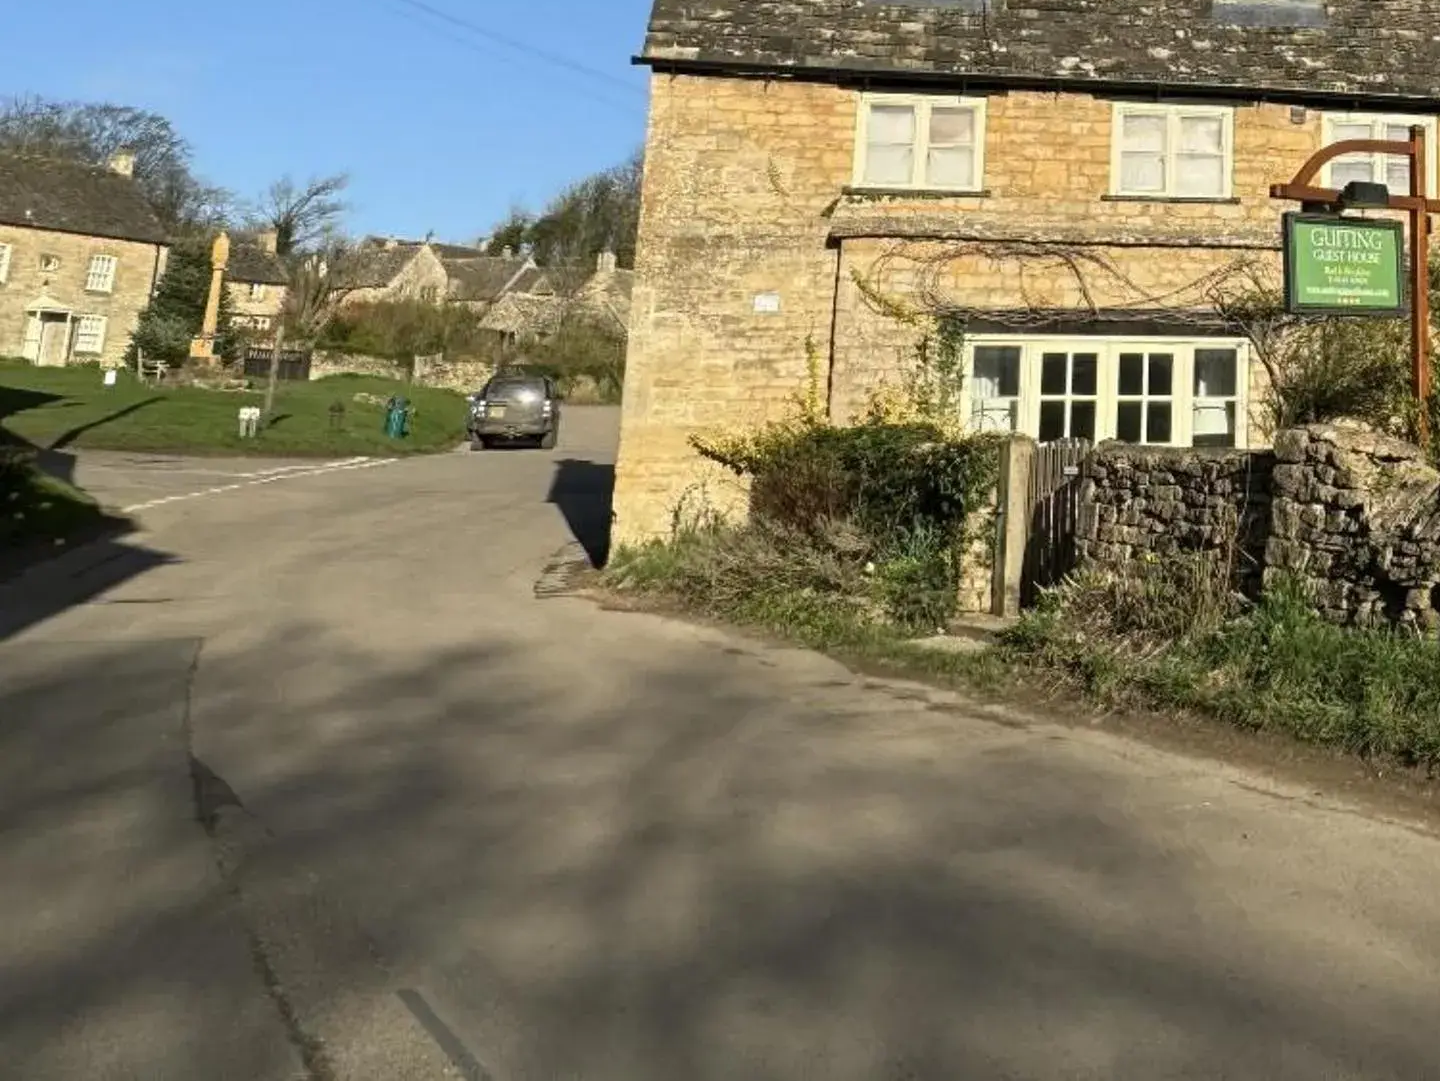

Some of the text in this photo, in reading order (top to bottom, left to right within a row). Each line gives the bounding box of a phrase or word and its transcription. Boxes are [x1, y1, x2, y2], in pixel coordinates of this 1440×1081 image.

[1311, 227, 1382, 250] GUITING
[1313, 249, 1381, 264] GUEST HOUSE
